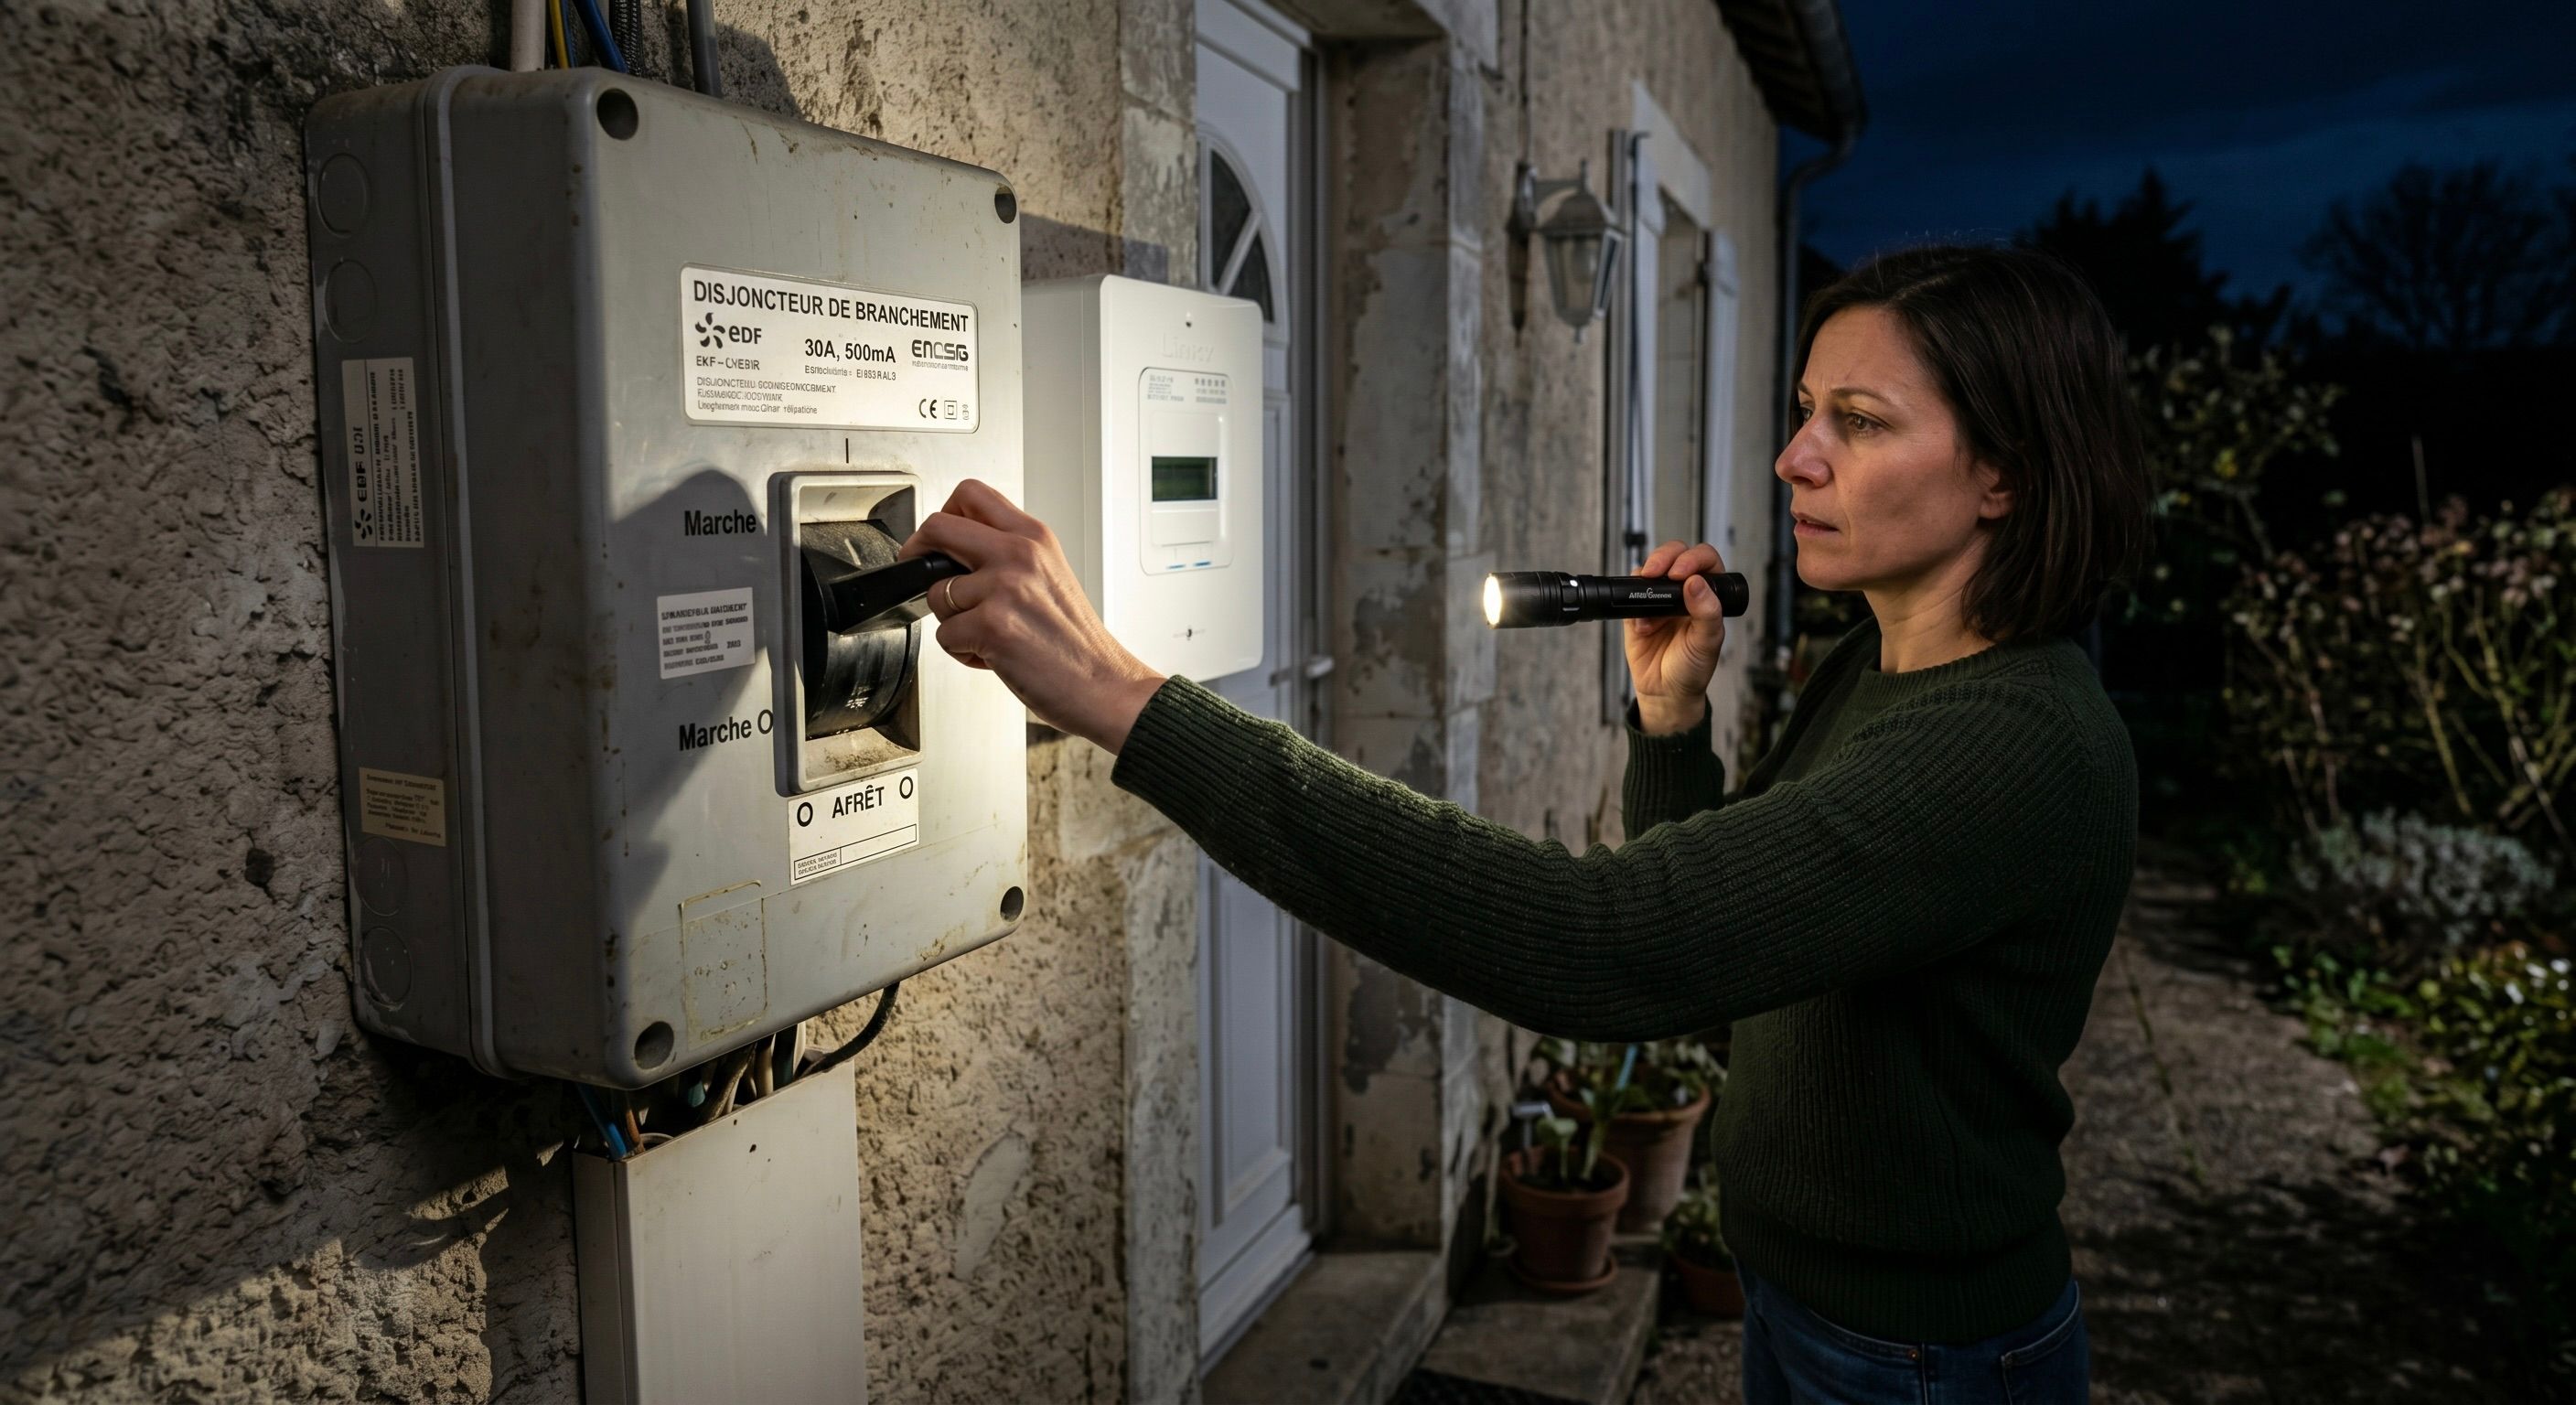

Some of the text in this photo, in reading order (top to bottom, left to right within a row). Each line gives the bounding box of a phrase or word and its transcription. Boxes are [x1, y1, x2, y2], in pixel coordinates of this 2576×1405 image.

[693, 280, 970, 333] DISJONCTEUR DE BRANCHEMENT
[805, 338, 896, 363] 30A, 500mA
[684, 509, 757, 537] Marche
[679, 716, 752, 751] Marche
[832, 784, 886, 819] AFRÊT
